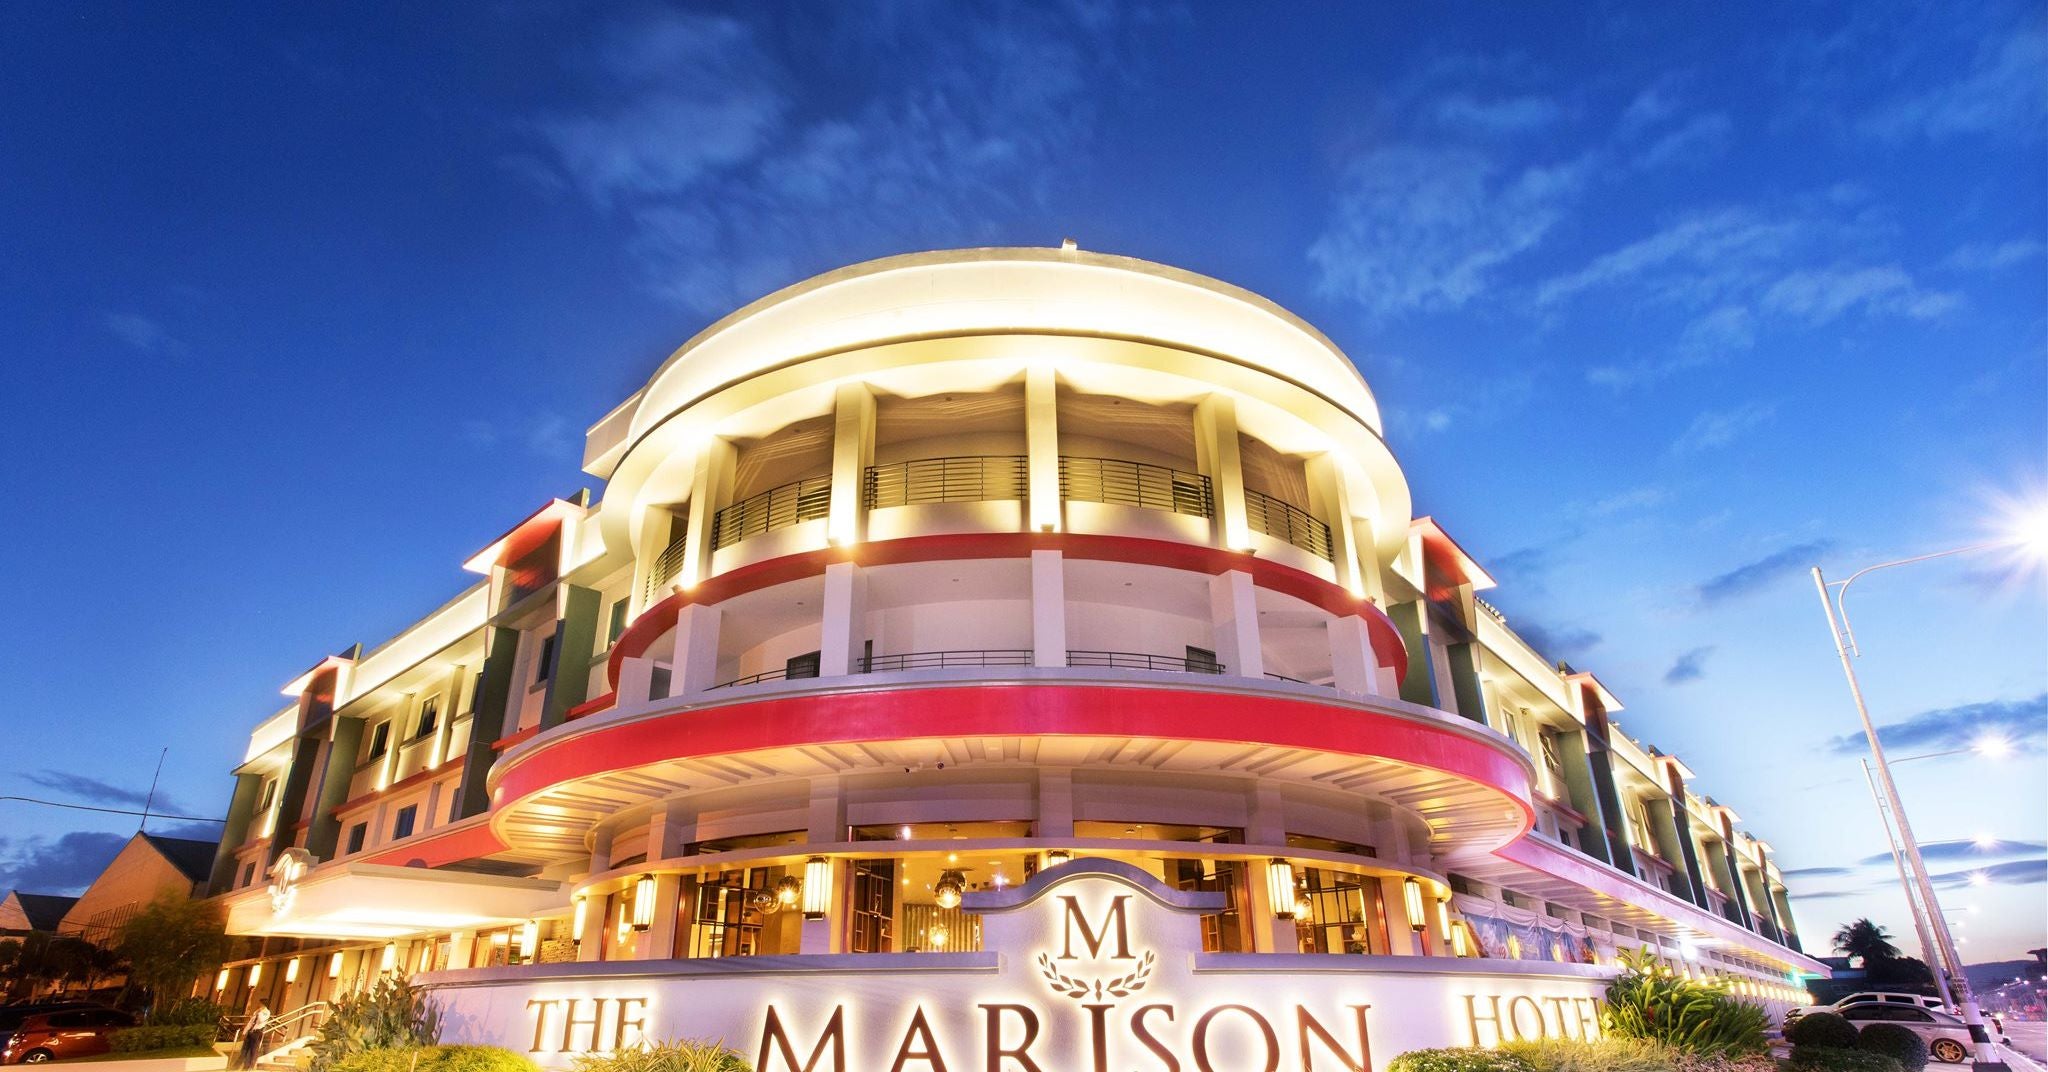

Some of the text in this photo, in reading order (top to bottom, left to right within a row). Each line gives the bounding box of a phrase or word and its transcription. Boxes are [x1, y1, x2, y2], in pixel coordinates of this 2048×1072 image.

[1056, 895, 1136, 960] M
[526, 997, 648, 1053] THE
[756, 1003, 1372, 1072] MARISON
